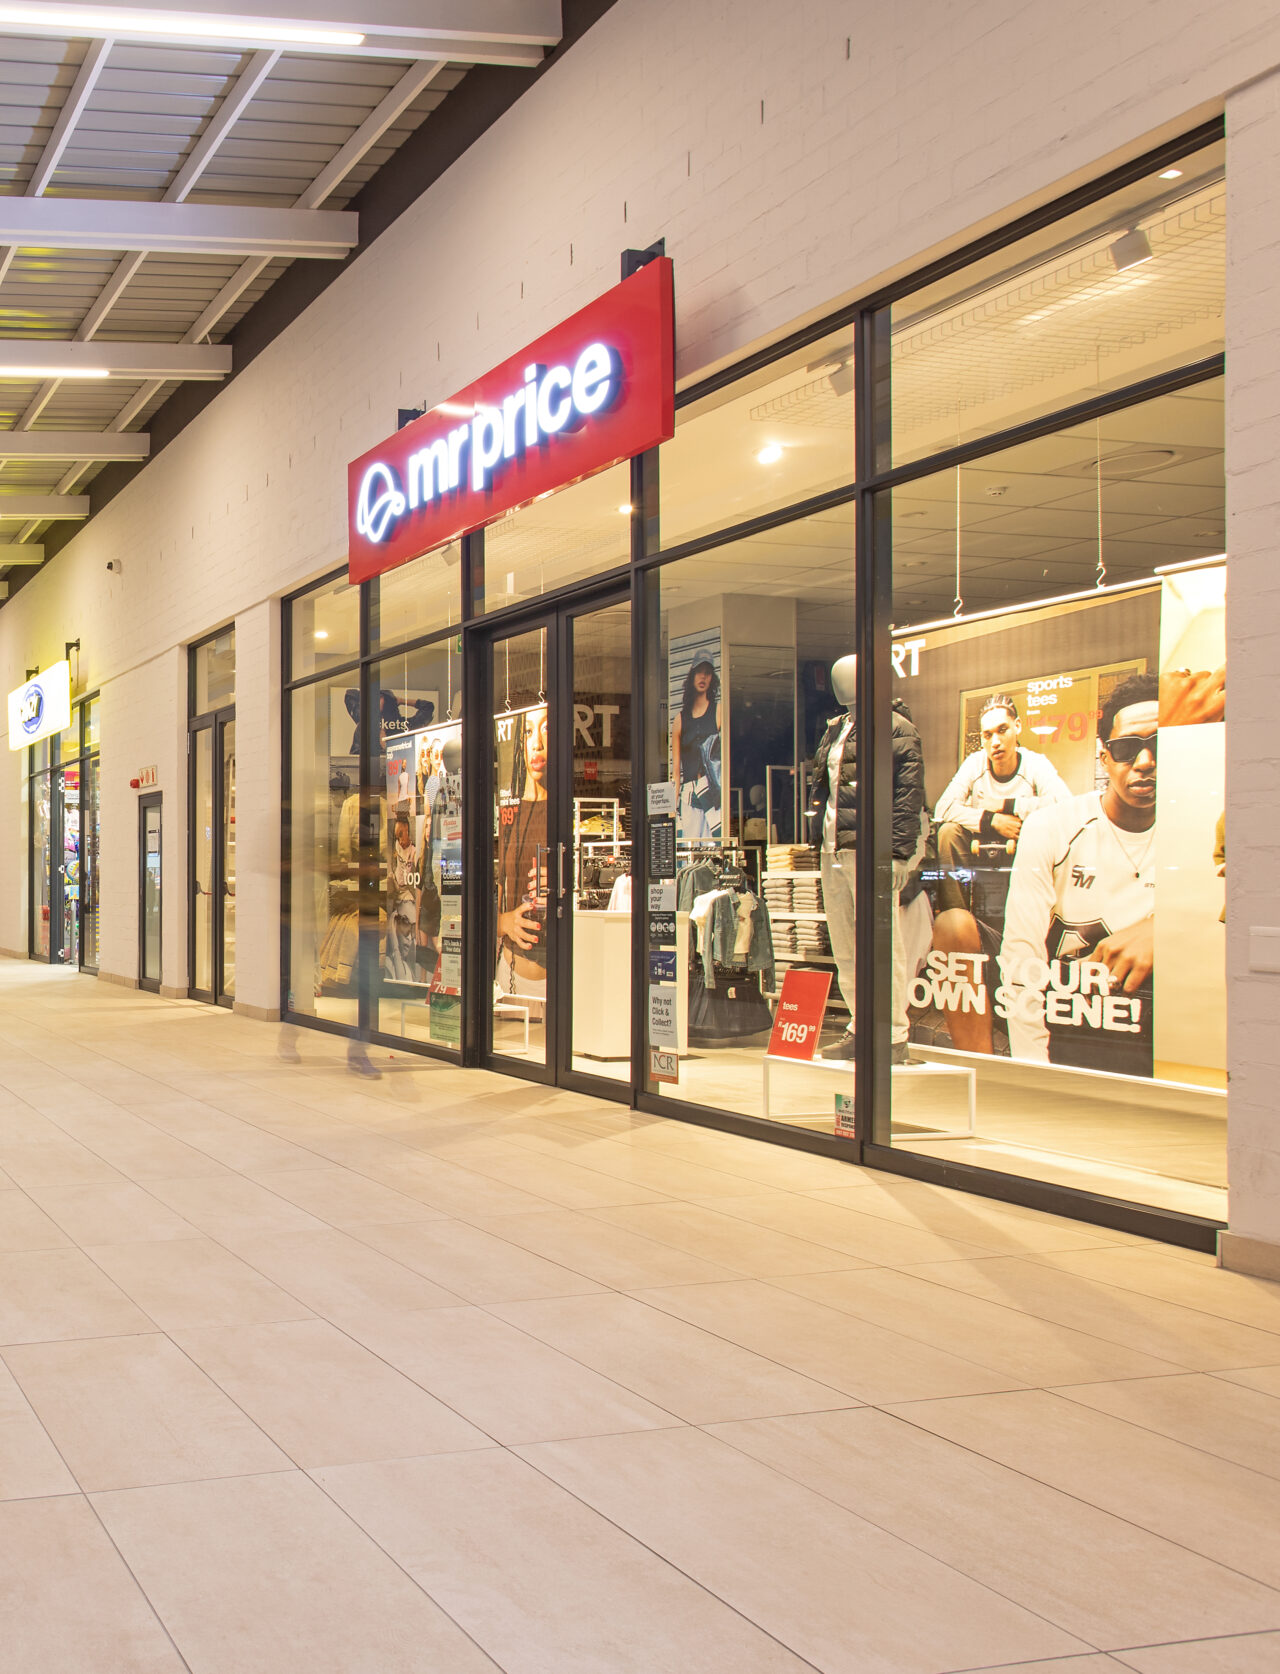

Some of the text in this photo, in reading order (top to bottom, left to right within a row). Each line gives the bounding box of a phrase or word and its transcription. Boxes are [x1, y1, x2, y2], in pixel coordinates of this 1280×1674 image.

[892, 638, 927, 679] RT
[1026, 676, 1073, 695] sports
[1026, 693, 1058, 707] tees
[497, 718, 514, 742] RT
[573, 703, 620, 748] RT
[650, 887, 664, 896] shop
[926, 950, 1111, 997] SET YOUR
[651, 995, 672, 1006] Why not
[782, 1001, 799, 1011] tees
[907, 977, 1142, 1034] OWN SCENE!
[651, 1006, 670, 1016] Click &
[651, 1017, 672, 1027] Collect?
[653, 1053, 675, 1071] NCR
